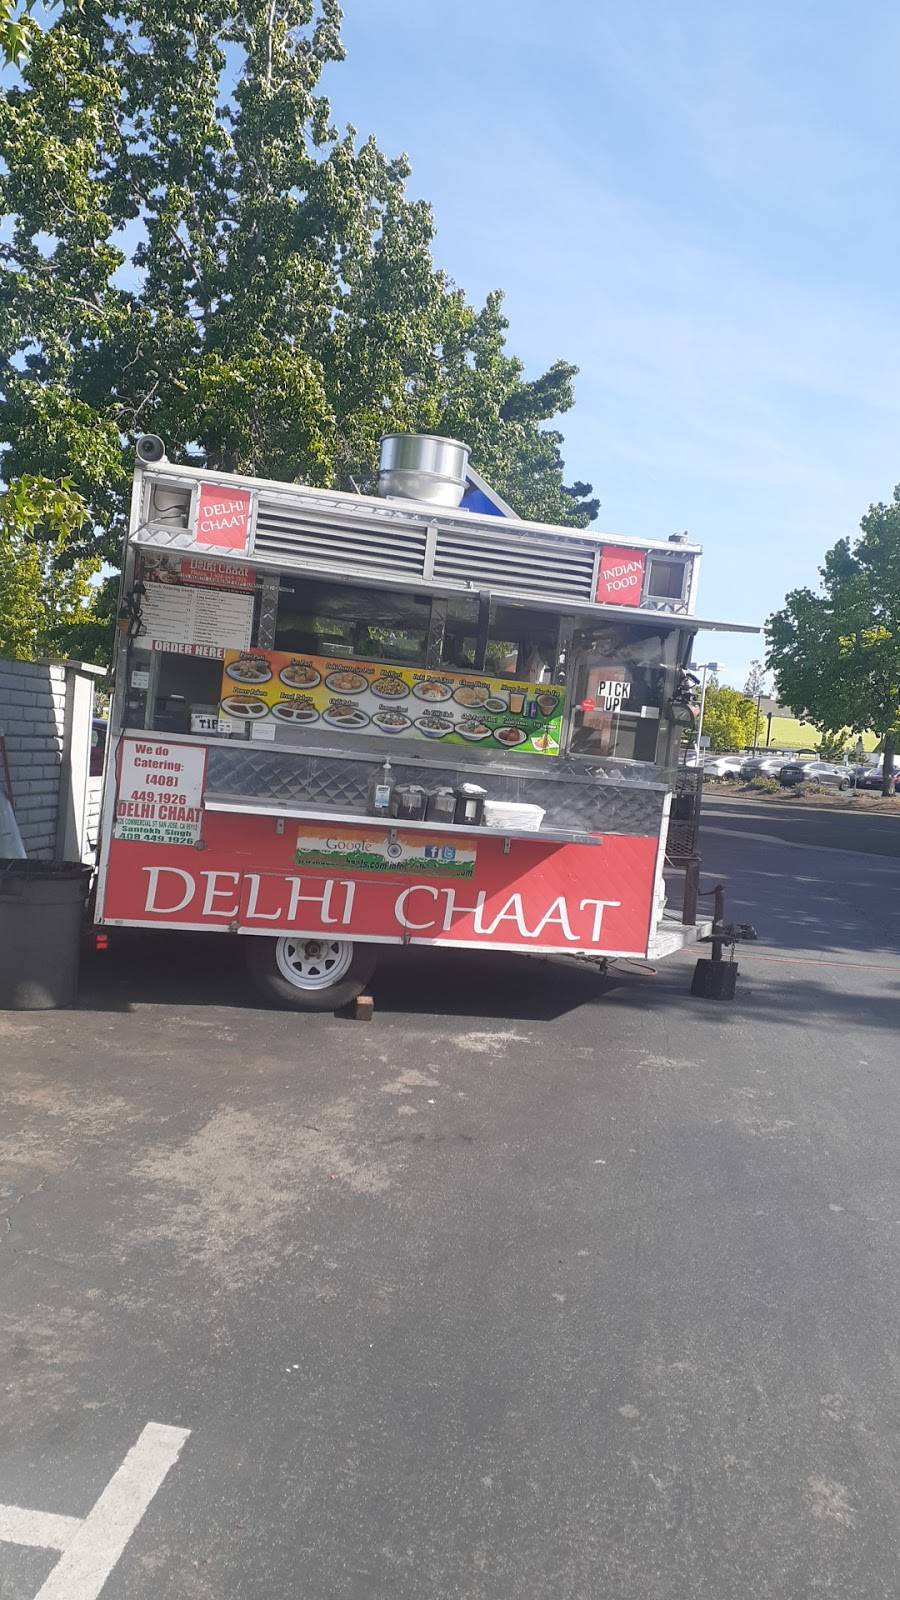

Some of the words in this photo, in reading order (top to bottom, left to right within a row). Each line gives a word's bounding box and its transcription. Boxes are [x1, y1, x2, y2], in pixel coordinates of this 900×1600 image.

[203, 500, 244, 517] DELHI
[200, 514, 246, 532] CHAAT
[603, 560, 642, 580] INDIAN
[606, 575, 638, 592] FOOD
[154, 640, 192, 654] ORDER
[195, 645, 224, 658] HERE
[599, 681, 629, 697] PICK
[605, 697, 620, 711] UP
[135, 744, 153, 755] We
[155, 746, 169, 756] do
[134, 757, 185, 772] Catering:
[146, 774, 178, 787] (408)
[131, 790, 187, 805] 449.1926
[117, 802, 155, 818] DELHI
[159, 805, 202, 823] CHAAT
[122, 825, 161, 834] Santokh
[165, 829, 192, 837] Singh
[326, 838, 372, 852] Google
[142, 865, 356, 926] DELHI
[394, 884, 622, 942] CHAAT
